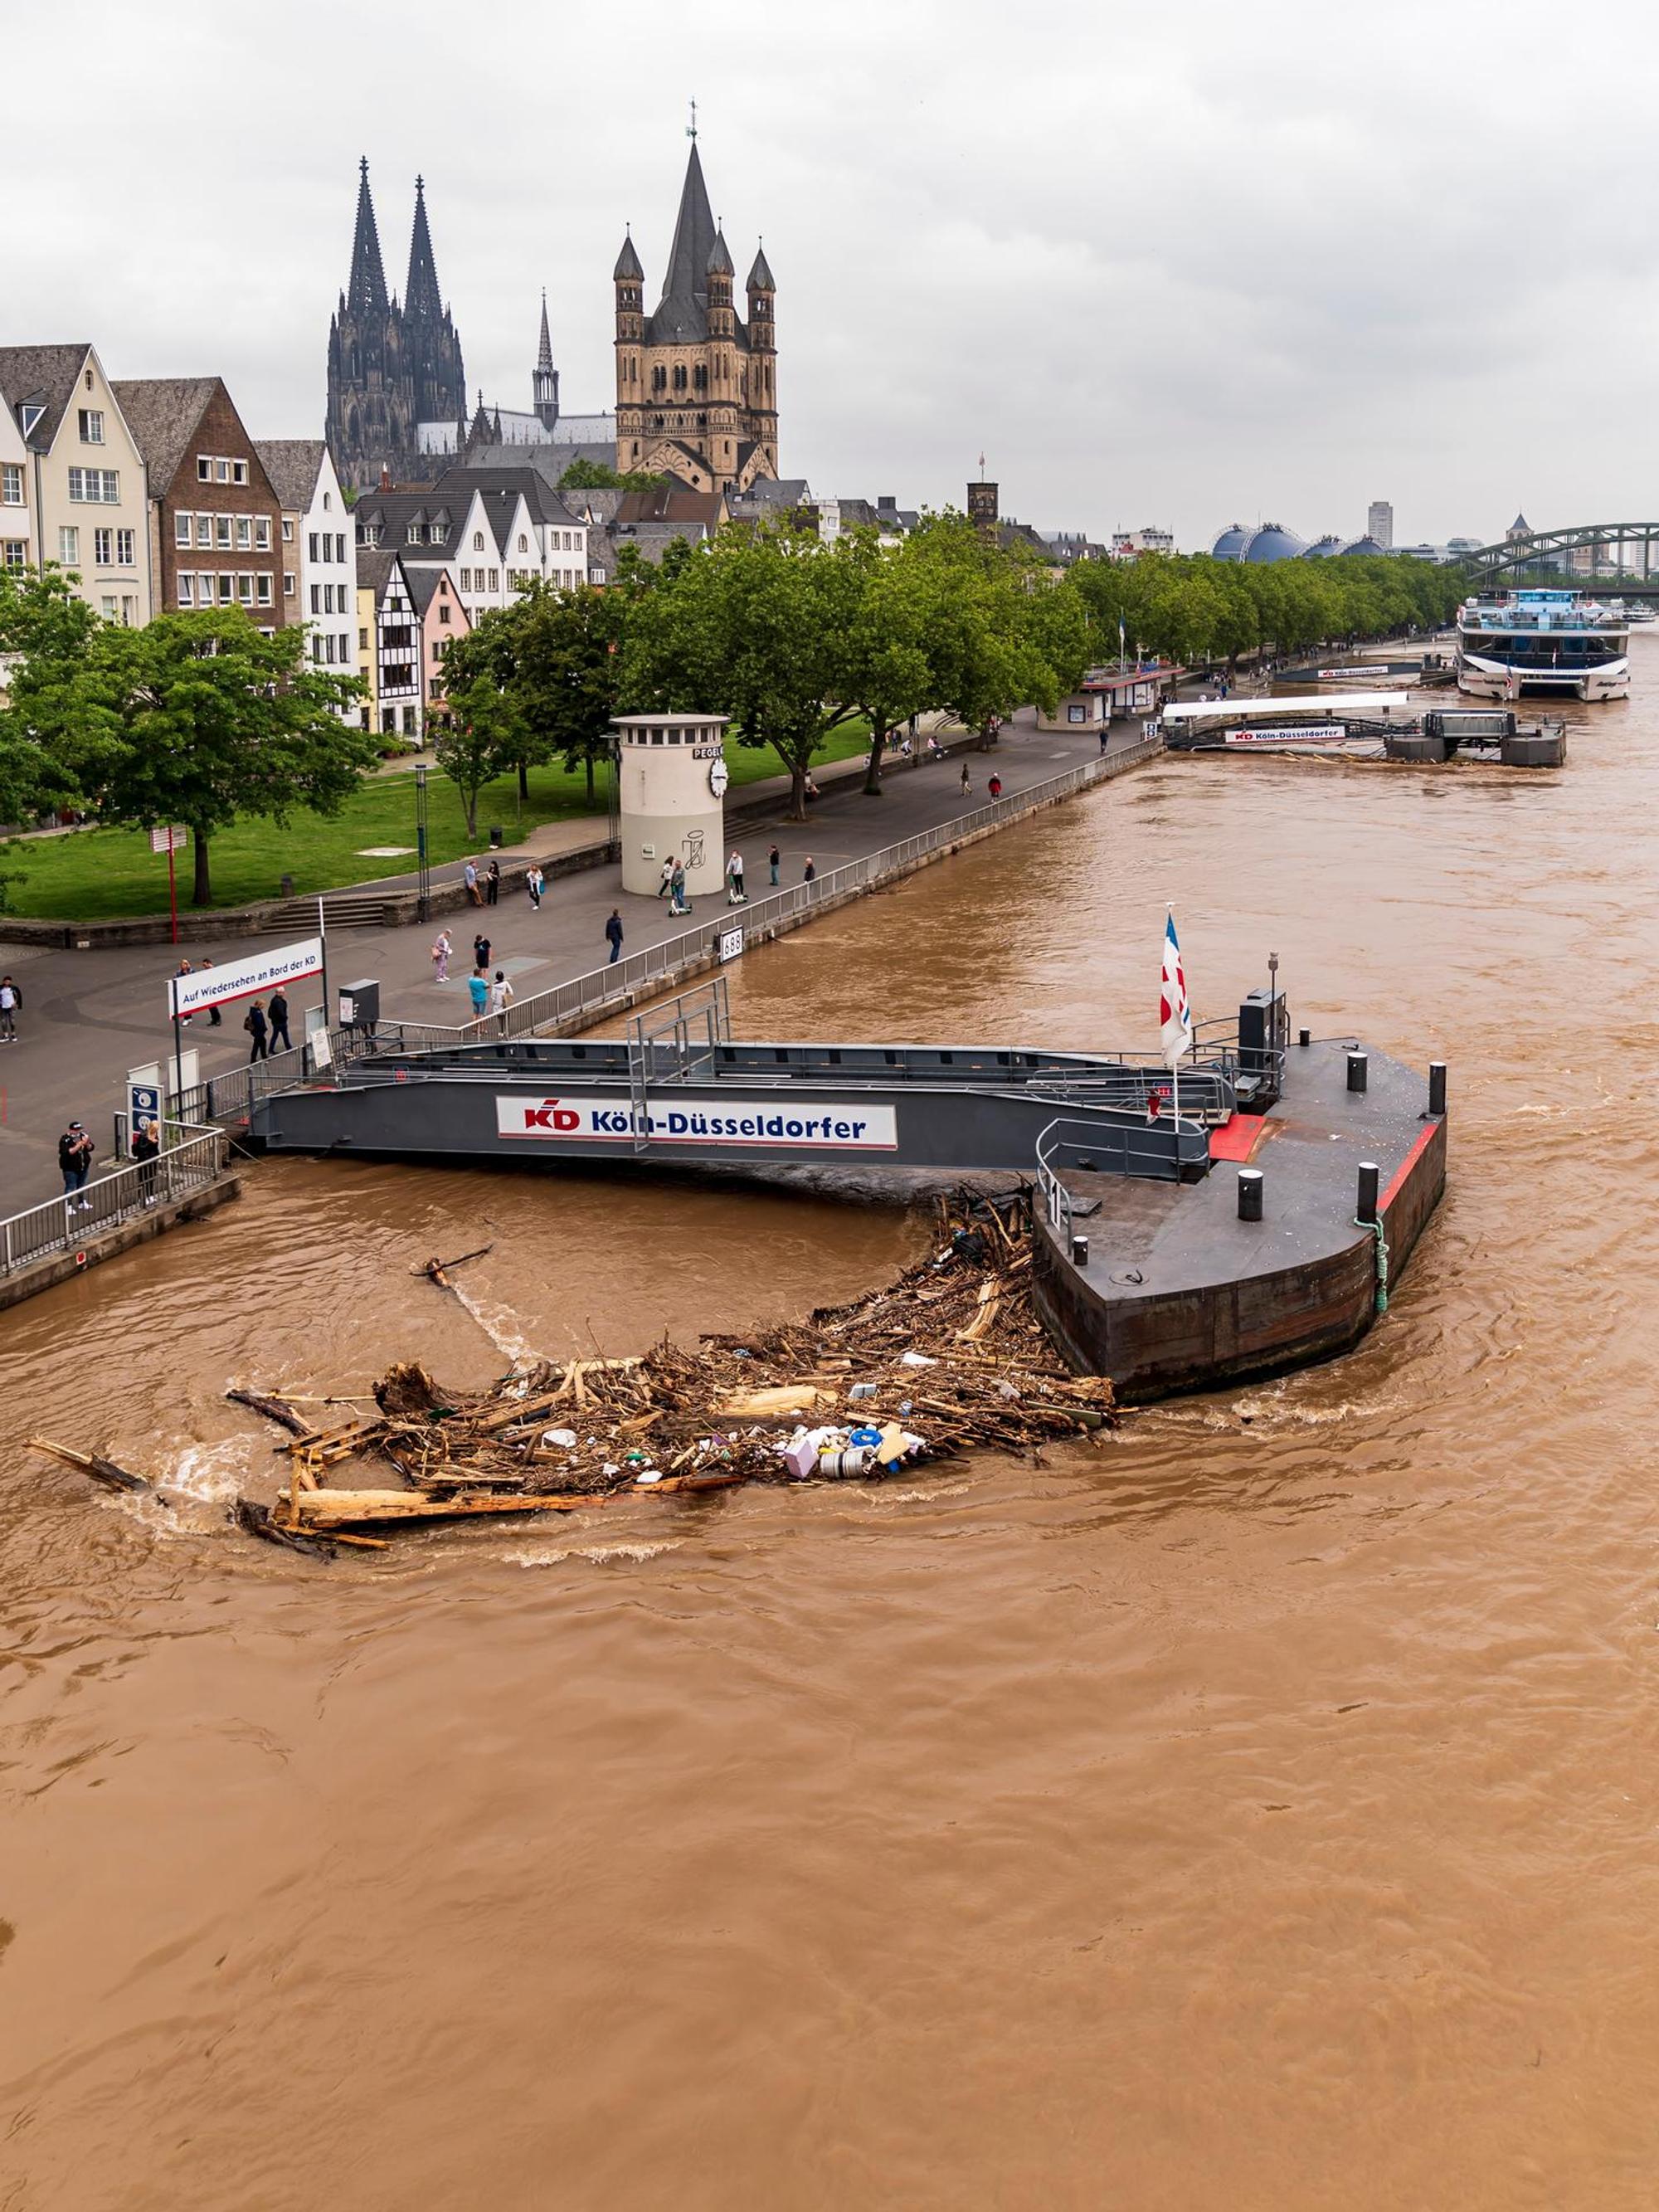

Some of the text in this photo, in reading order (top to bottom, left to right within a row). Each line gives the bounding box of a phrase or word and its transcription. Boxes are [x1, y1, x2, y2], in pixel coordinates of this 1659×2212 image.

[1256, 730, 1339, 739] Köln-Düsseldorfer
[694, 748, 719, 758] PEGEL
[725, 934, 741, 954] 688
[182, 955, 316, 1004] Auf Wiedersehen an Bord der KD
[524, 1107, 867, 1139] KD Köln-Düsseldorfer
